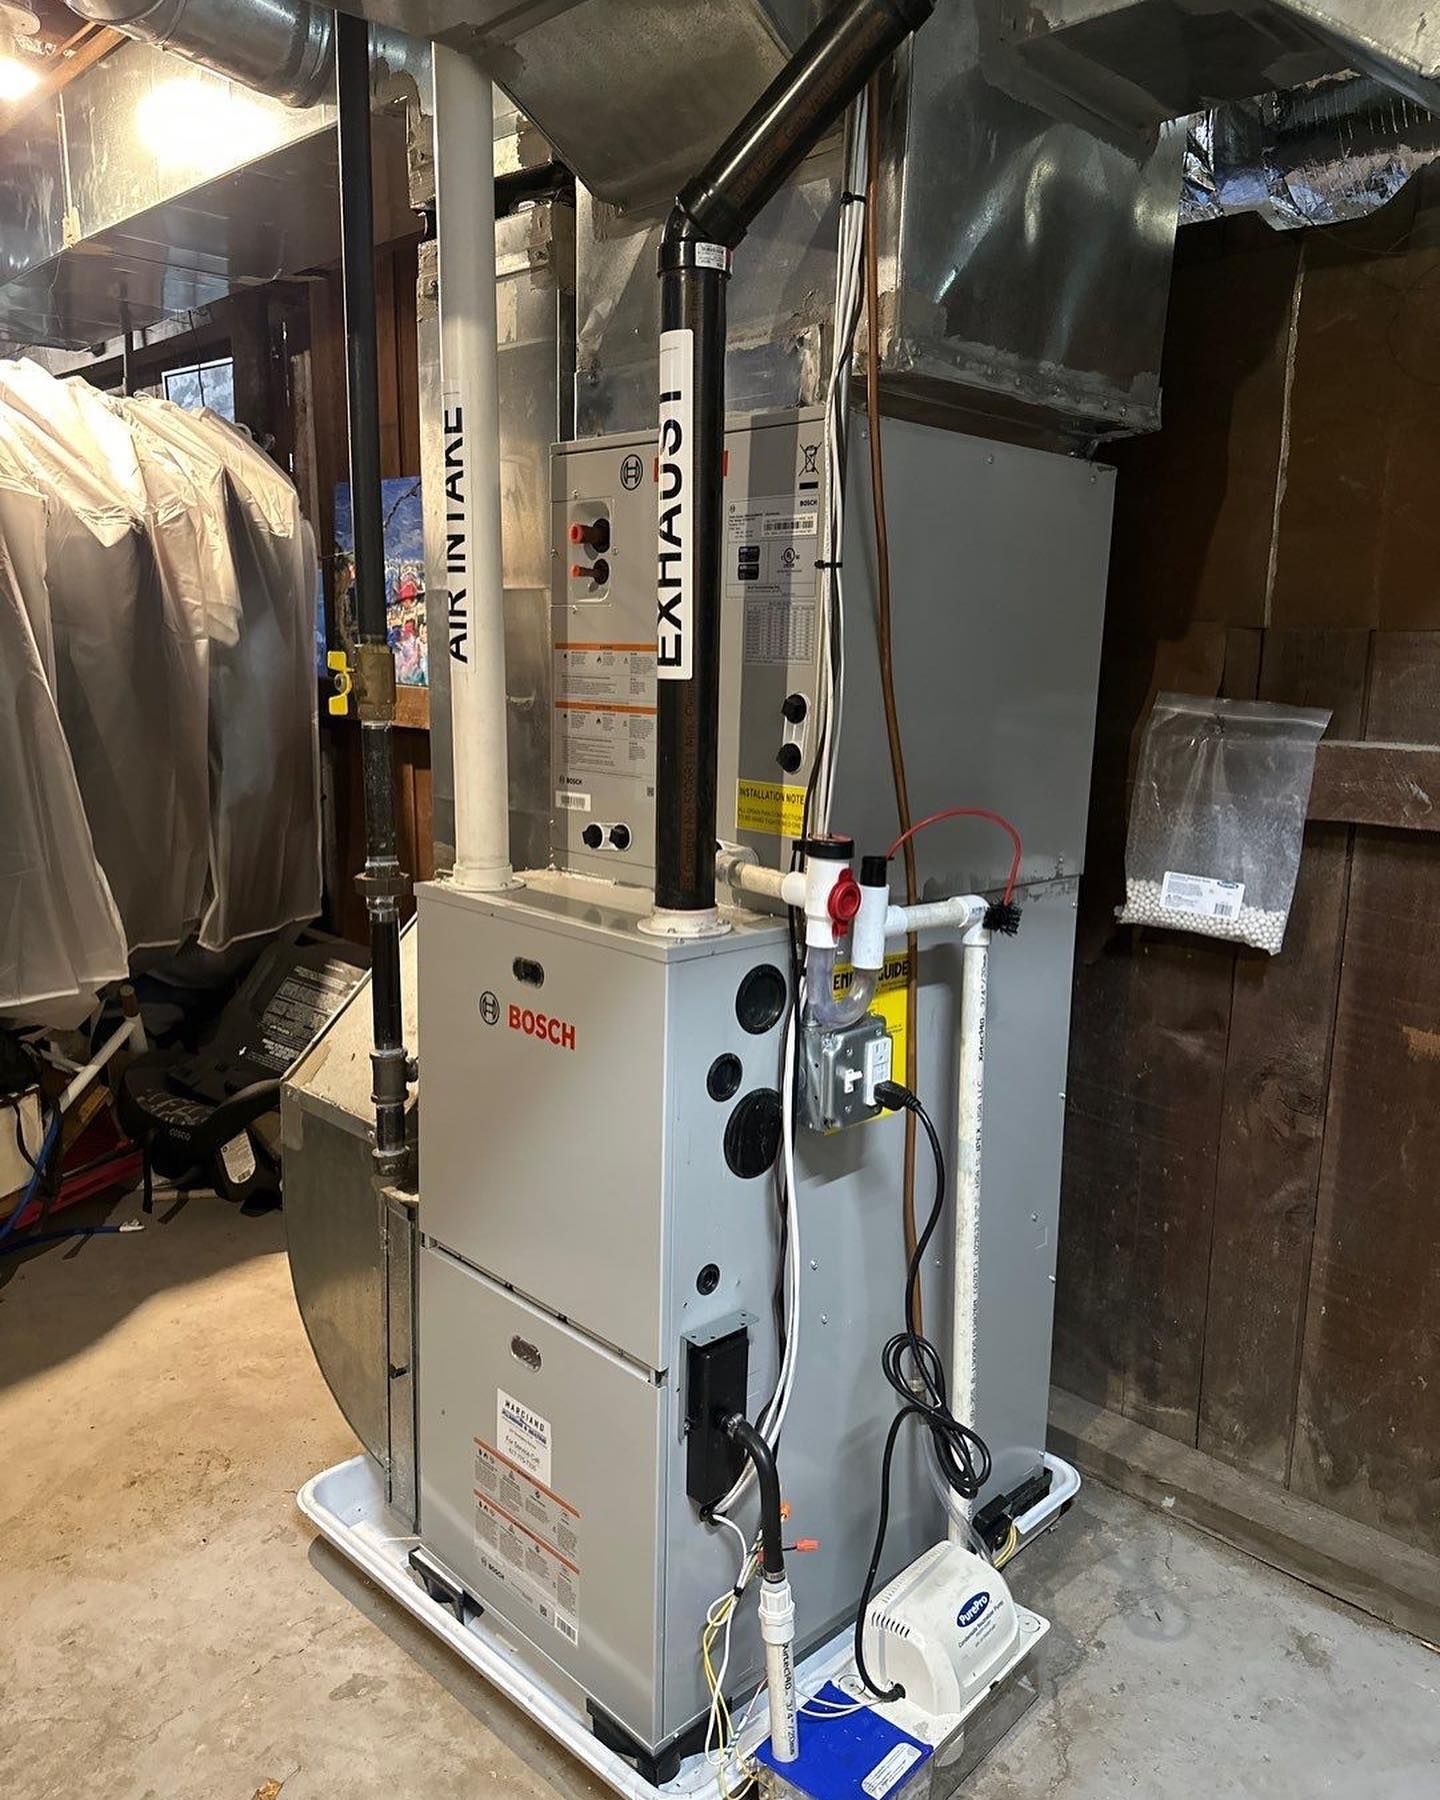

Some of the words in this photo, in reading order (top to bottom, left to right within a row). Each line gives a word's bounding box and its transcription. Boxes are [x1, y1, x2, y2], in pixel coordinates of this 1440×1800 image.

[448, 588, 468, 665] AIR
[566, 776, 583, 786] BOSCH
[740, 787, 784, 802] INSTALLATION
[508, 1004, 576, 1051] BOSCH
[505, 1401, 545, 1432] MARCIANO
[958, 1595, 988, 1626] PurePro
